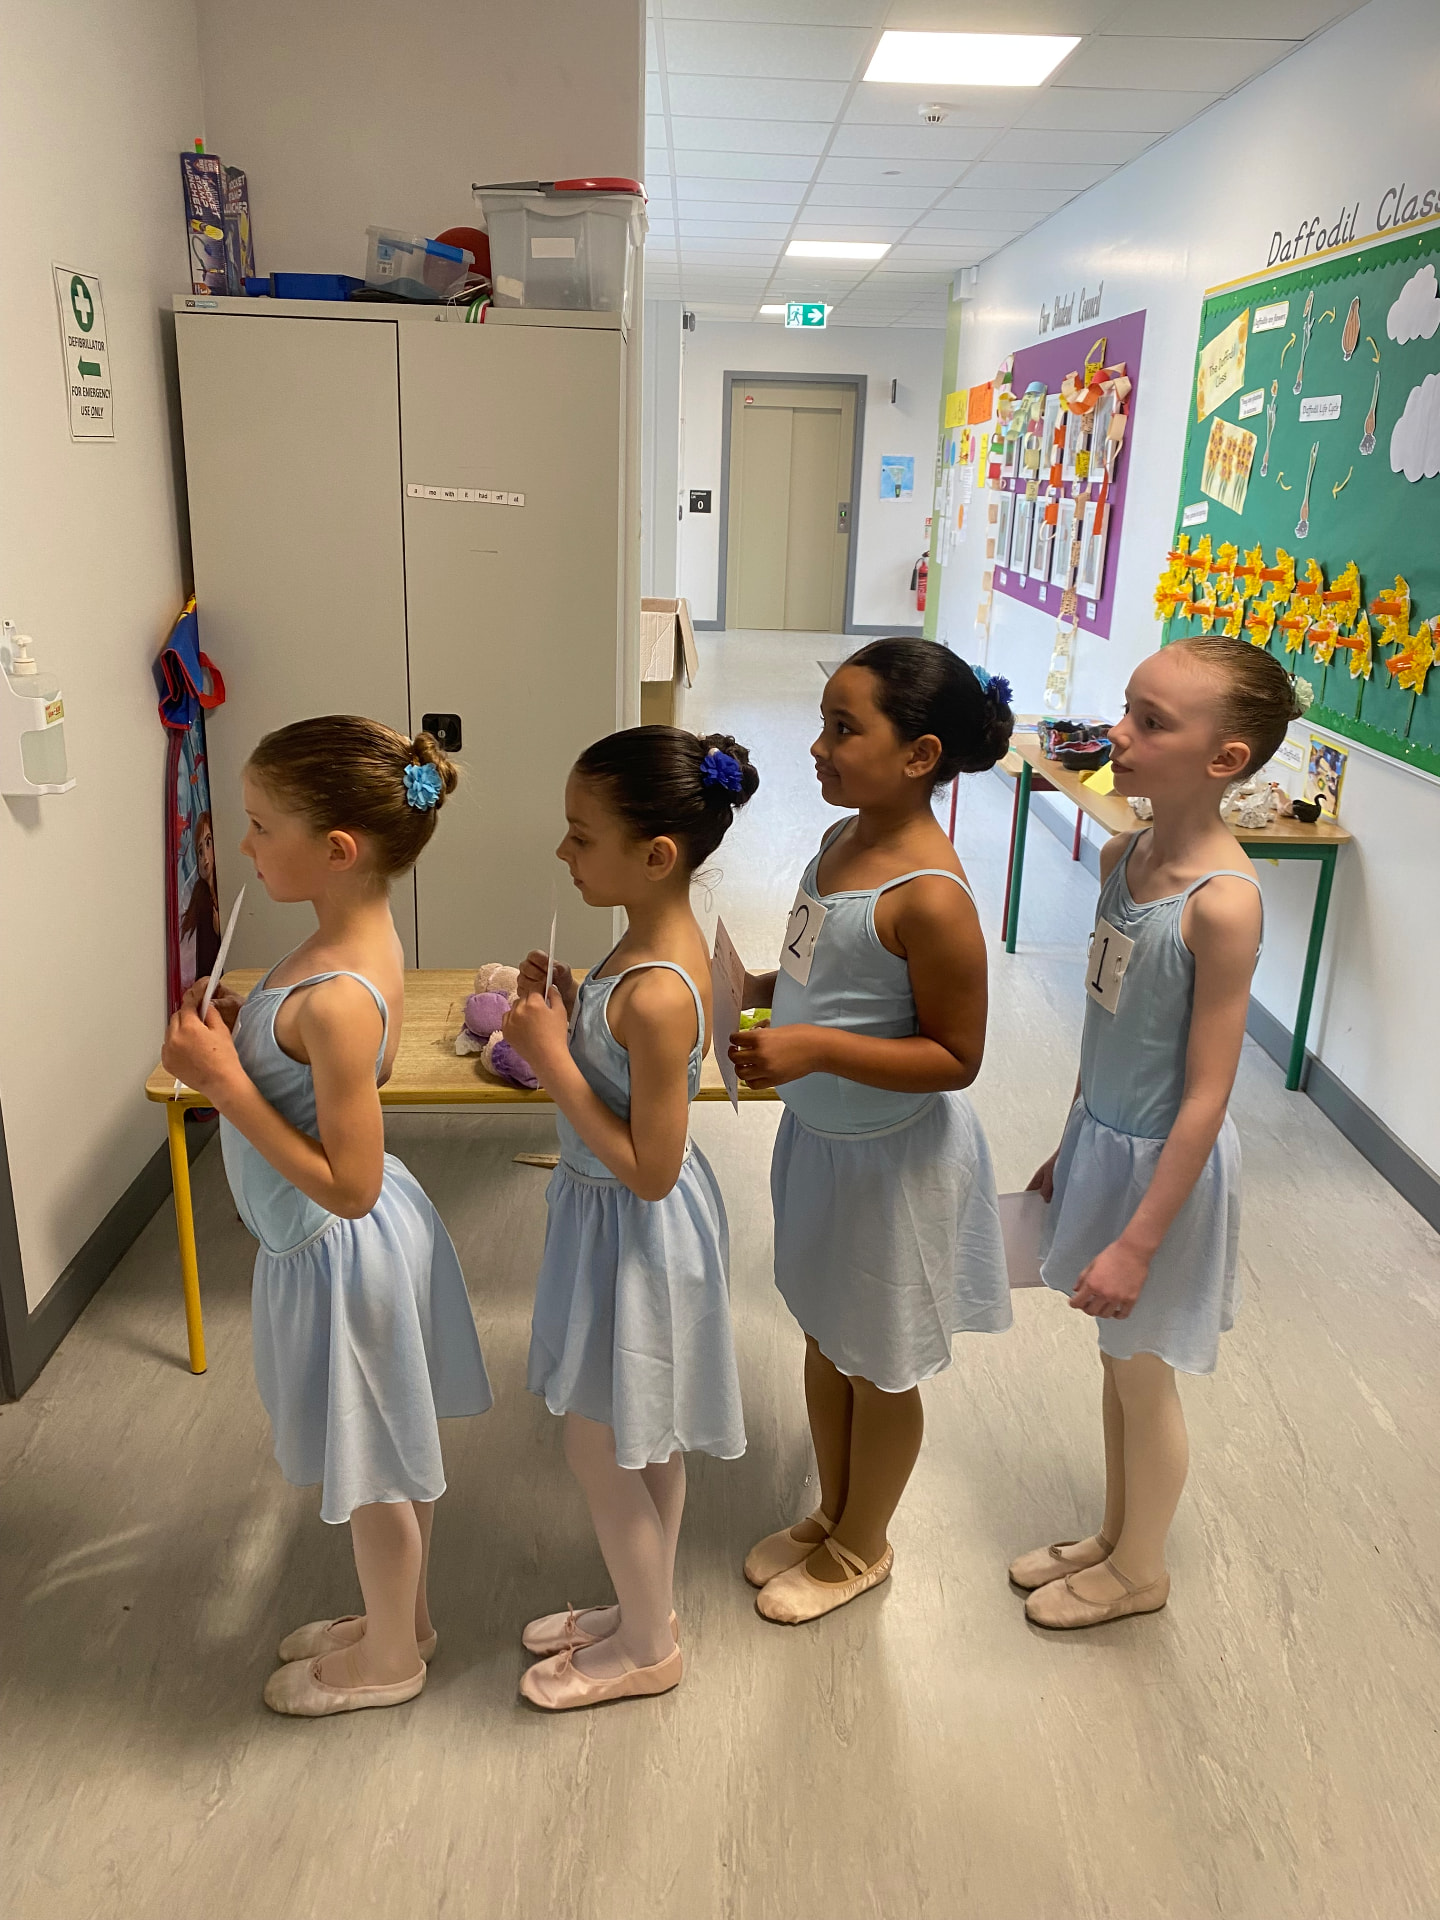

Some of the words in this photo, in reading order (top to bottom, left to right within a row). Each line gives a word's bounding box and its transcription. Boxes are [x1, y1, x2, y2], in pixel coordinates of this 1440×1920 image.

[184, 159, 203, 216] LAUNCHER
[194, 175, 208, 208] STAMP
[1267, 202, 1360, 267] Daffodil
[68, 335, 105, 351] DEFIBRILLATOR
[71, 385, 82, 397] FOR
[82, 386, 111, 399] EMERGENCY
[81, 406, 90, 416] USE
[90, 406, 103, 417] ONLY
[1302, 405, 1319, 416] Daffodil
[444, 489, 455, 498] with
[697, 500, 704, 510] 0
[788, 904, 809, 959] 2
[1091, 937, 1109, 994] 1
